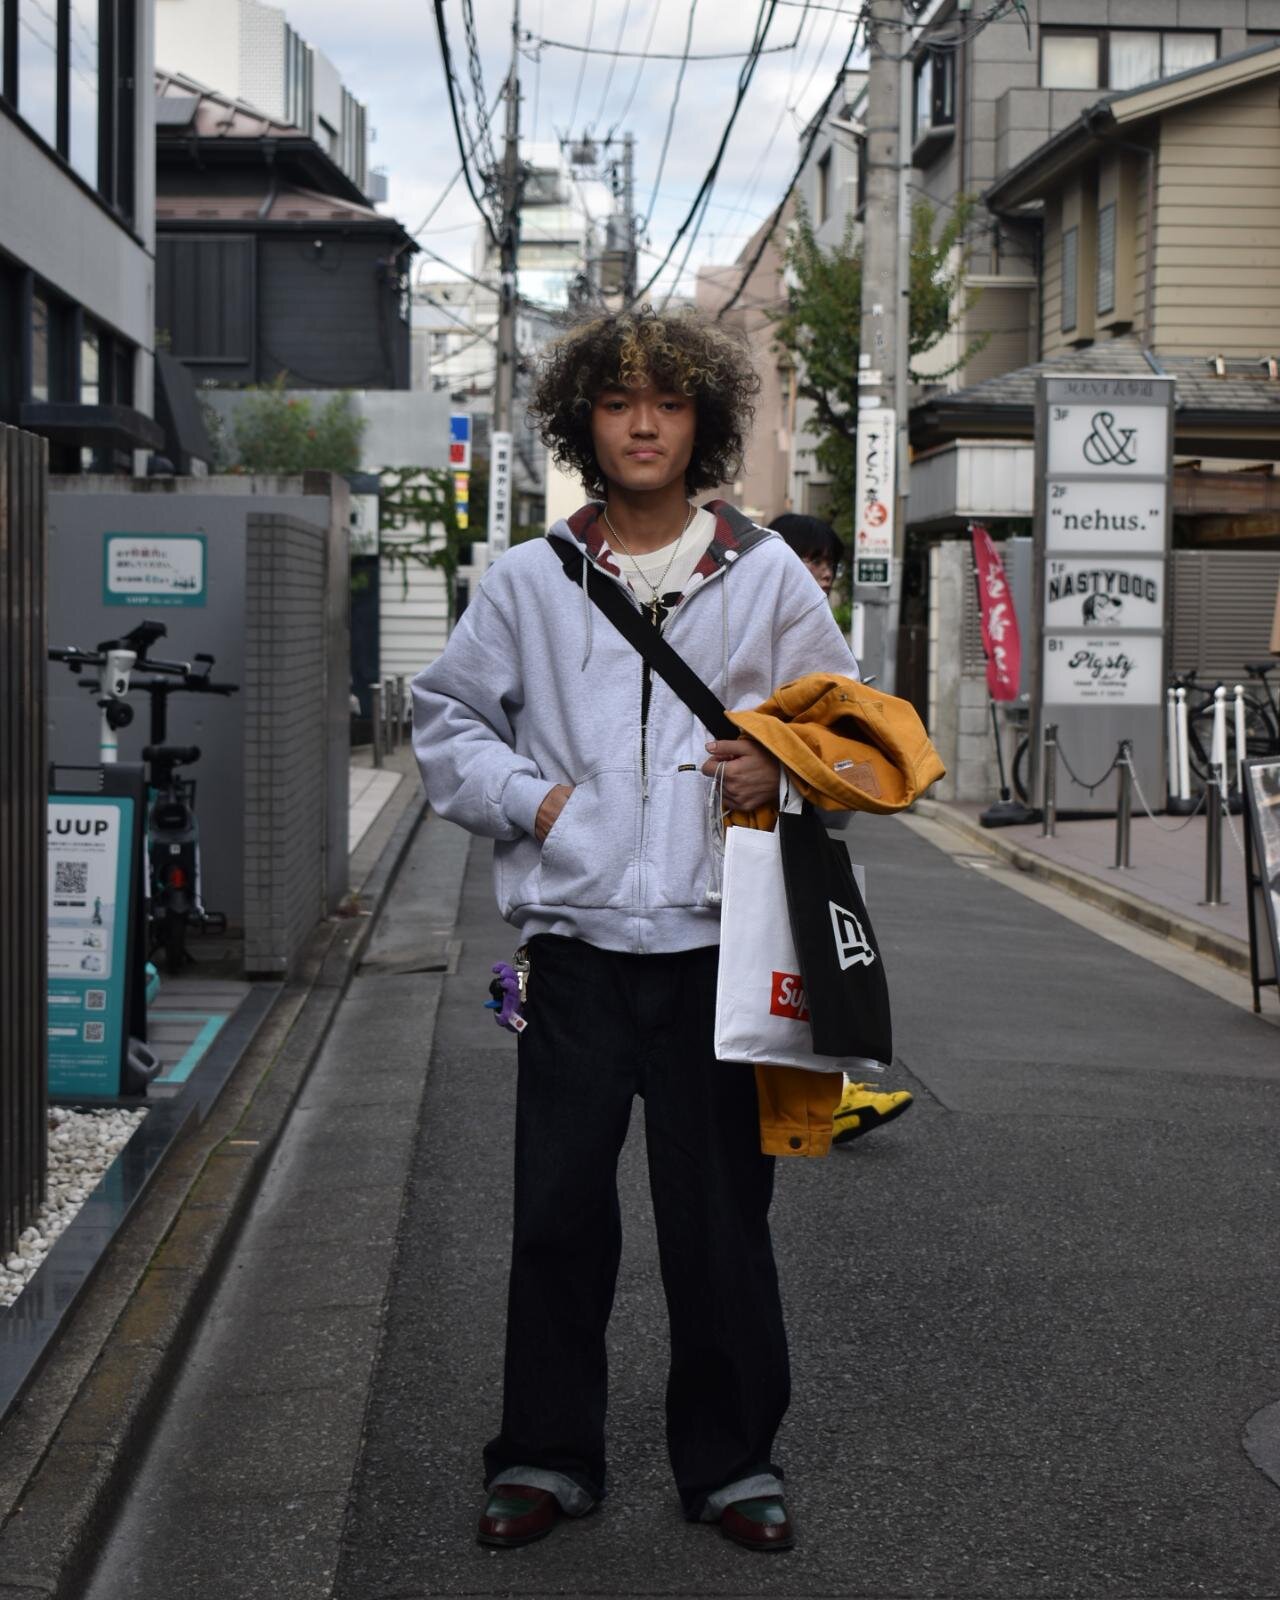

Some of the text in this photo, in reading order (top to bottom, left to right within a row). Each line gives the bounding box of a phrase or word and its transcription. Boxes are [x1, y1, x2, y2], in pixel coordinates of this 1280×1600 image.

[1053, 408, 1069, 421] 3F
[1083, 411, 1137, 465] &
[1051, 485, 1067, 498] 2F
[1051, 562, 1065, 573] 1F
[1048, 570, 1157, 603] NASTYDOG
[1048, 639, 1064, 652] B1
[1068, 650, 1137, 679] Pigsty
[47, 819, 109, 835] UUP
